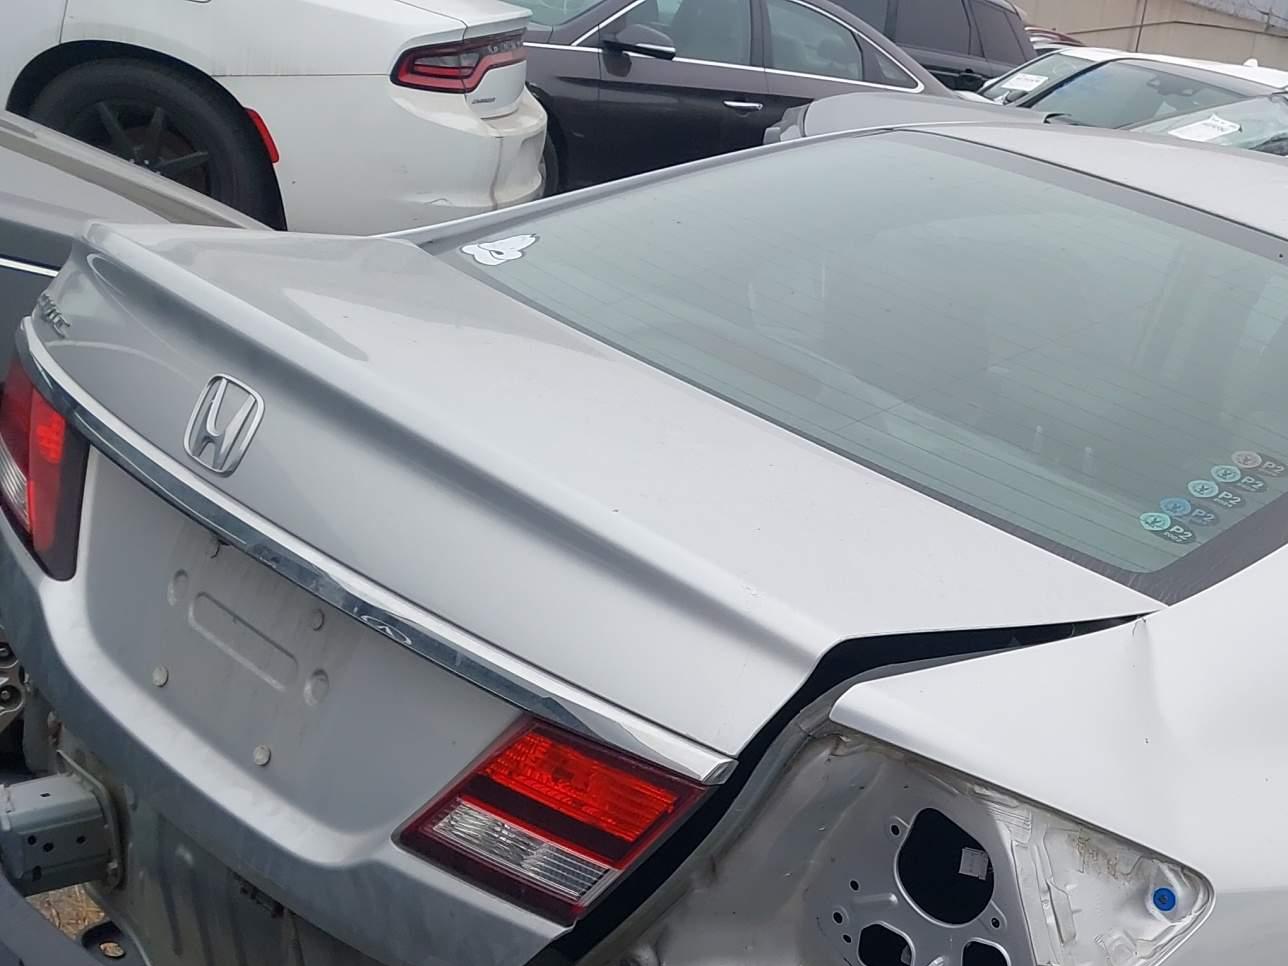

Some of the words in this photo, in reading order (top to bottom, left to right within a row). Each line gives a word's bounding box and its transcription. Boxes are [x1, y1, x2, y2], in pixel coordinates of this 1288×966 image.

[1262, 461, 1285, 473] P2
[1240, 476, 1264, 489] P2
[1218, 491, 1241, 505] P2
[1191, 508, 1216, 521] P2
[1169, 525, 1193, 540] P2
